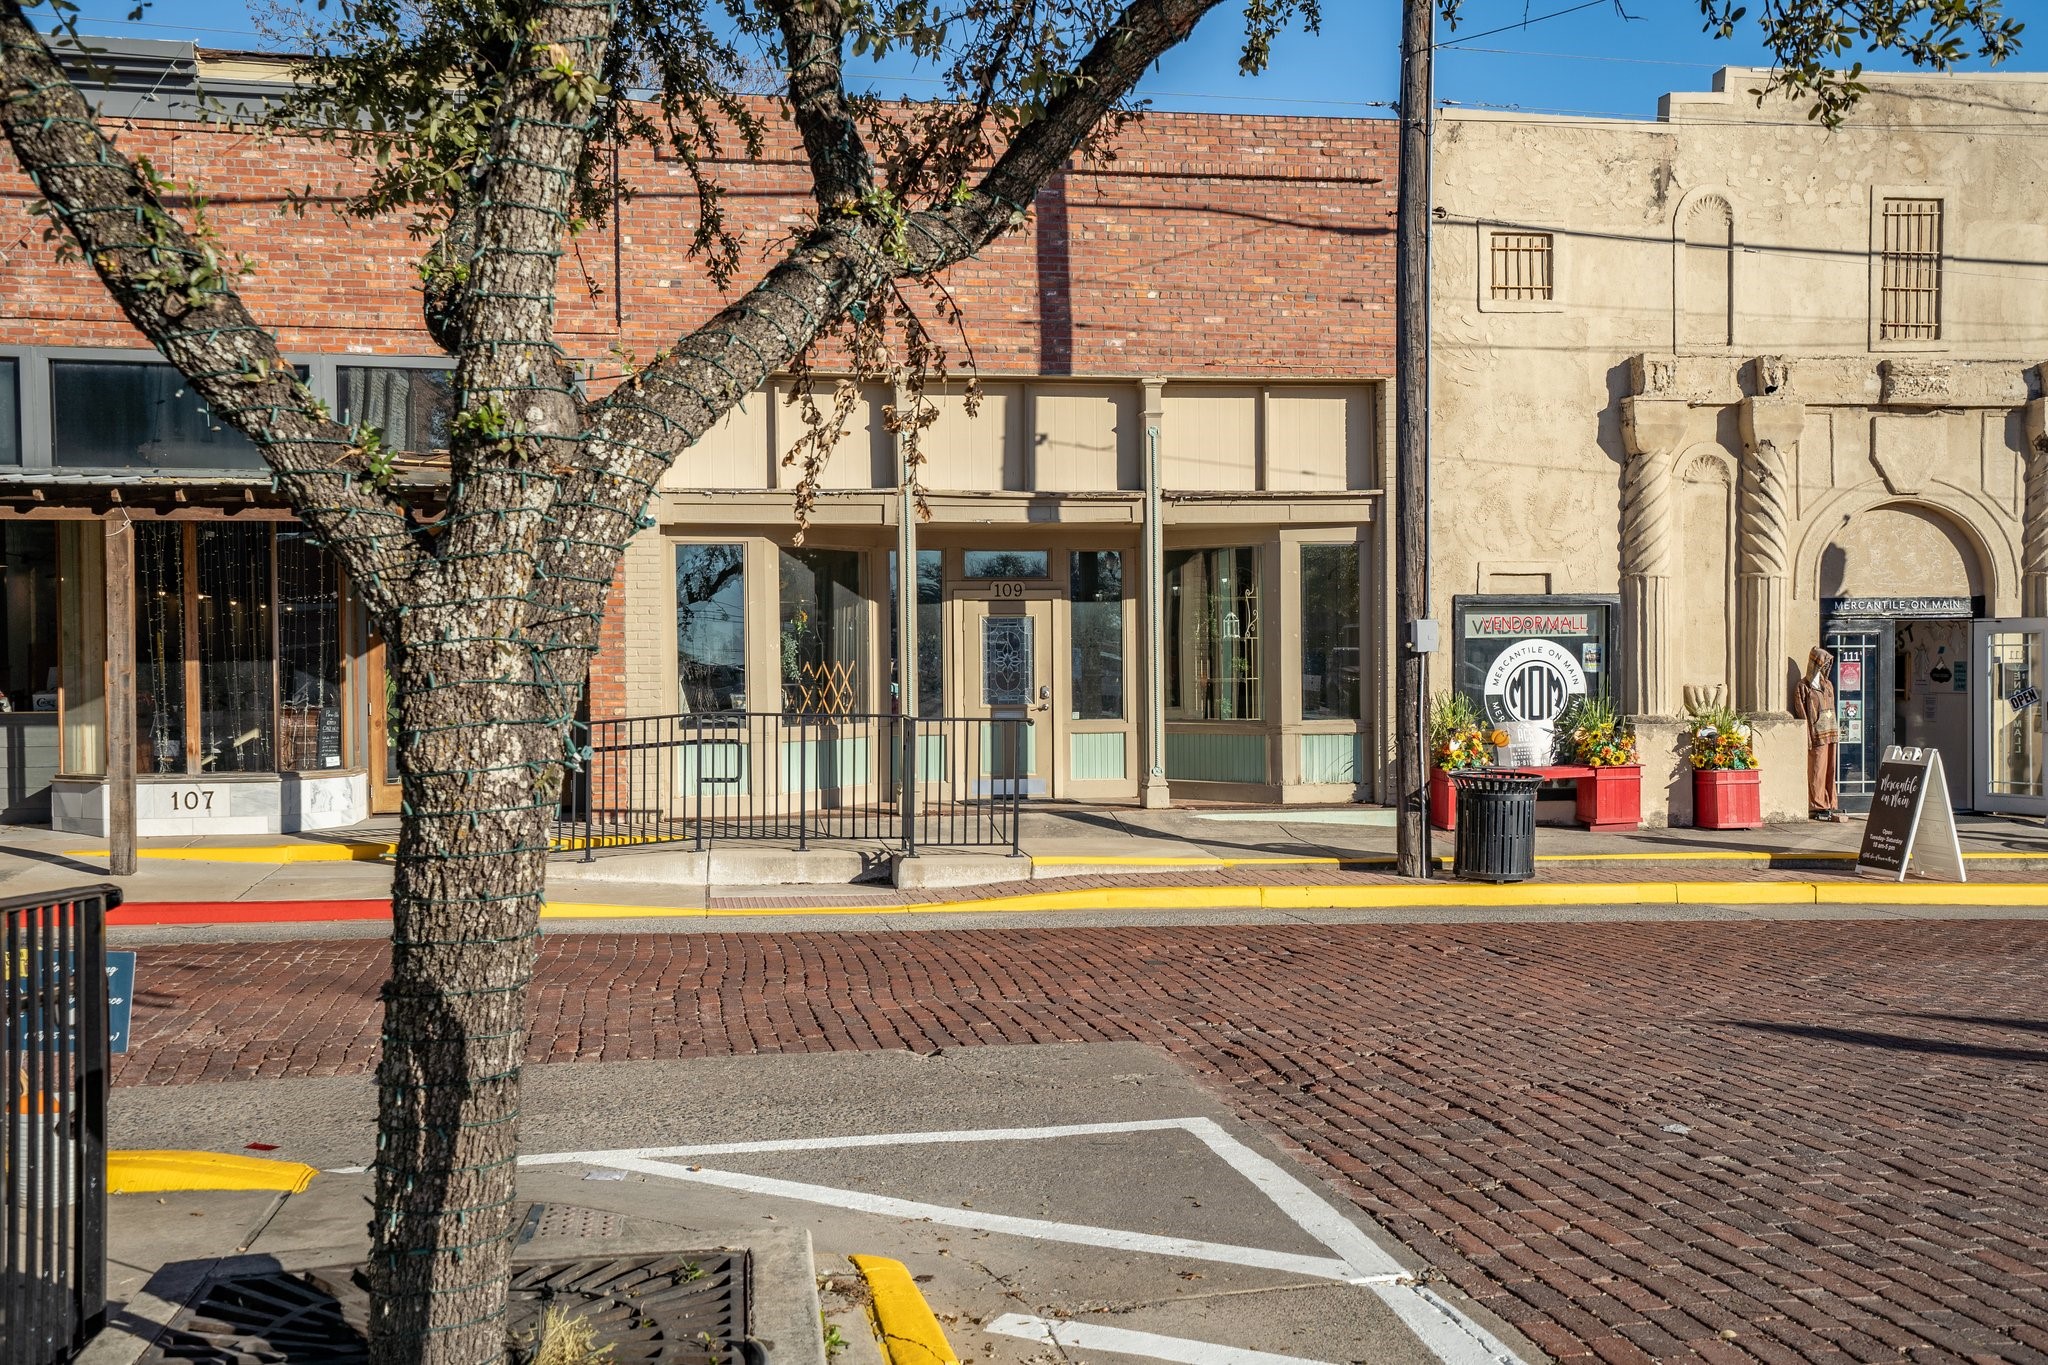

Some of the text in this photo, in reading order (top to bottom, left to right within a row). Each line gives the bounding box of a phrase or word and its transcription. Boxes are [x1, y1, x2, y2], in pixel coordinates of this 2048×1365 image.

[994, 583, 1023, 598] 109
[1834, 600, 1960, 610] MERCANTILE ON MAIN
[1481, 615, 1588, 631] VENDOR MALL
[1843, 651, 1860, 661] 111
[1492, 646, 1579, 686] MERCANTILE ON MAIN
[2010, 688, 2038, 710] OPEN
[1880, 773, 1919, 794] Mercantile
[171, 791, 214, 811] 107
[1890, 790, 1910, 809] Main
[1882, 828, 1893, 836] Open
